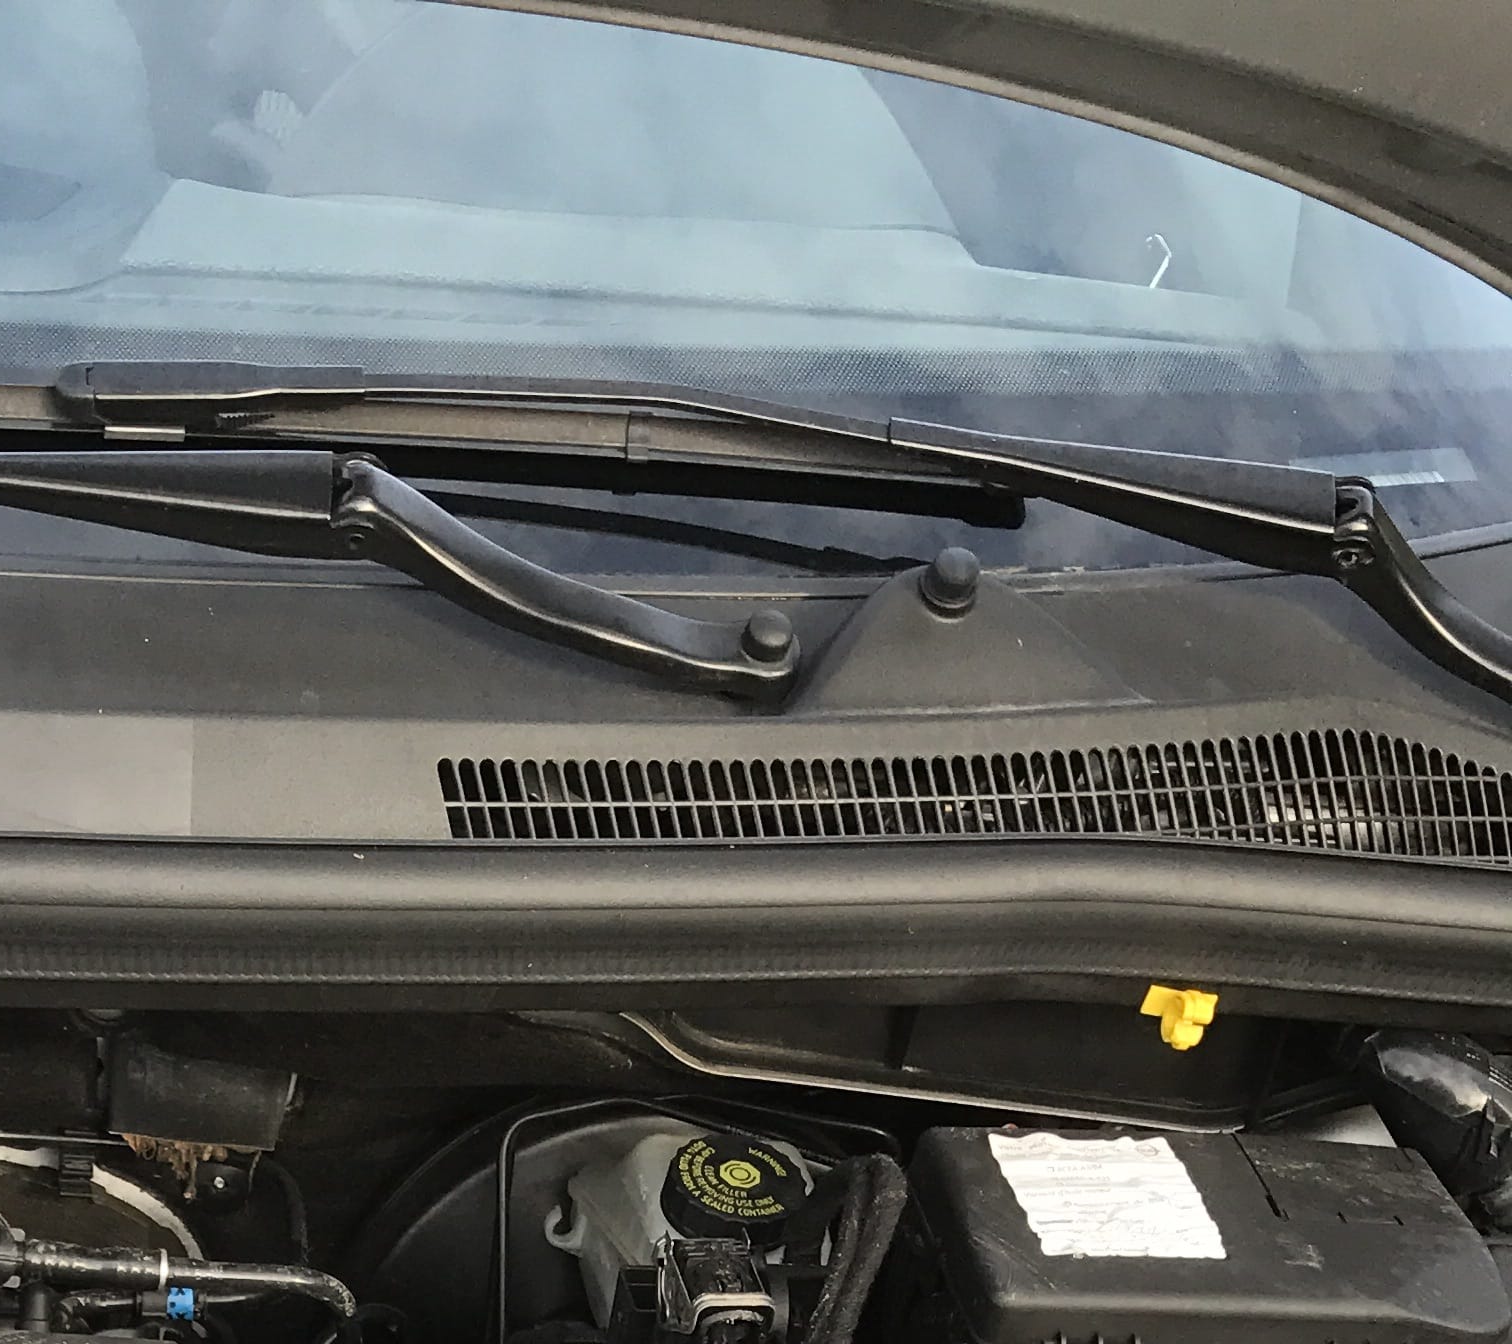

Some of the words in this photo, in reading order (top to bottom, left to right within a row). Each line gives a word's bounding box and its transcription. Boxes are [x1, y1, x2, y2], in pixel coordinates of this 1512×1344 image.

[696, 1177, 735, 1204] REMOVING
[735, 1199, 754, 1208] USE
[718, 1184, 748, 1198] FILLER
[700, 1195, 735, 1214] SEALED
